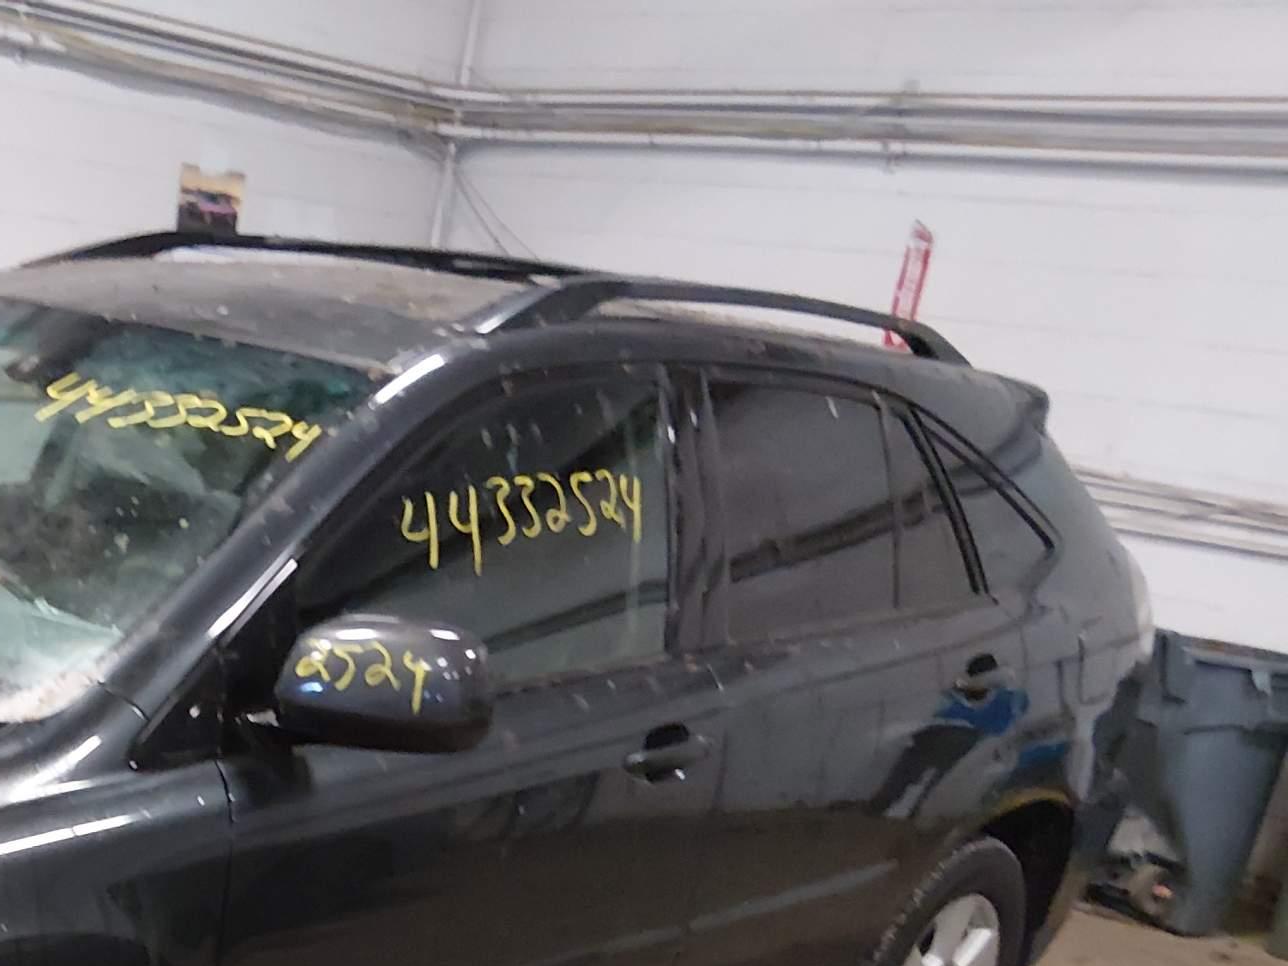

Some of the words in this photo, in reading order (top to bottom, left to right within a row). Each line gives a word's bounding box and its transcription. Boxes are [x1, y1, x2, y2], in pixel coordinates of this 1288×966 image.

[34, 372, 322, 463] 44332524
[400, 468, 643, 576] 44332524
[294, 637, 431, 715] 2524
